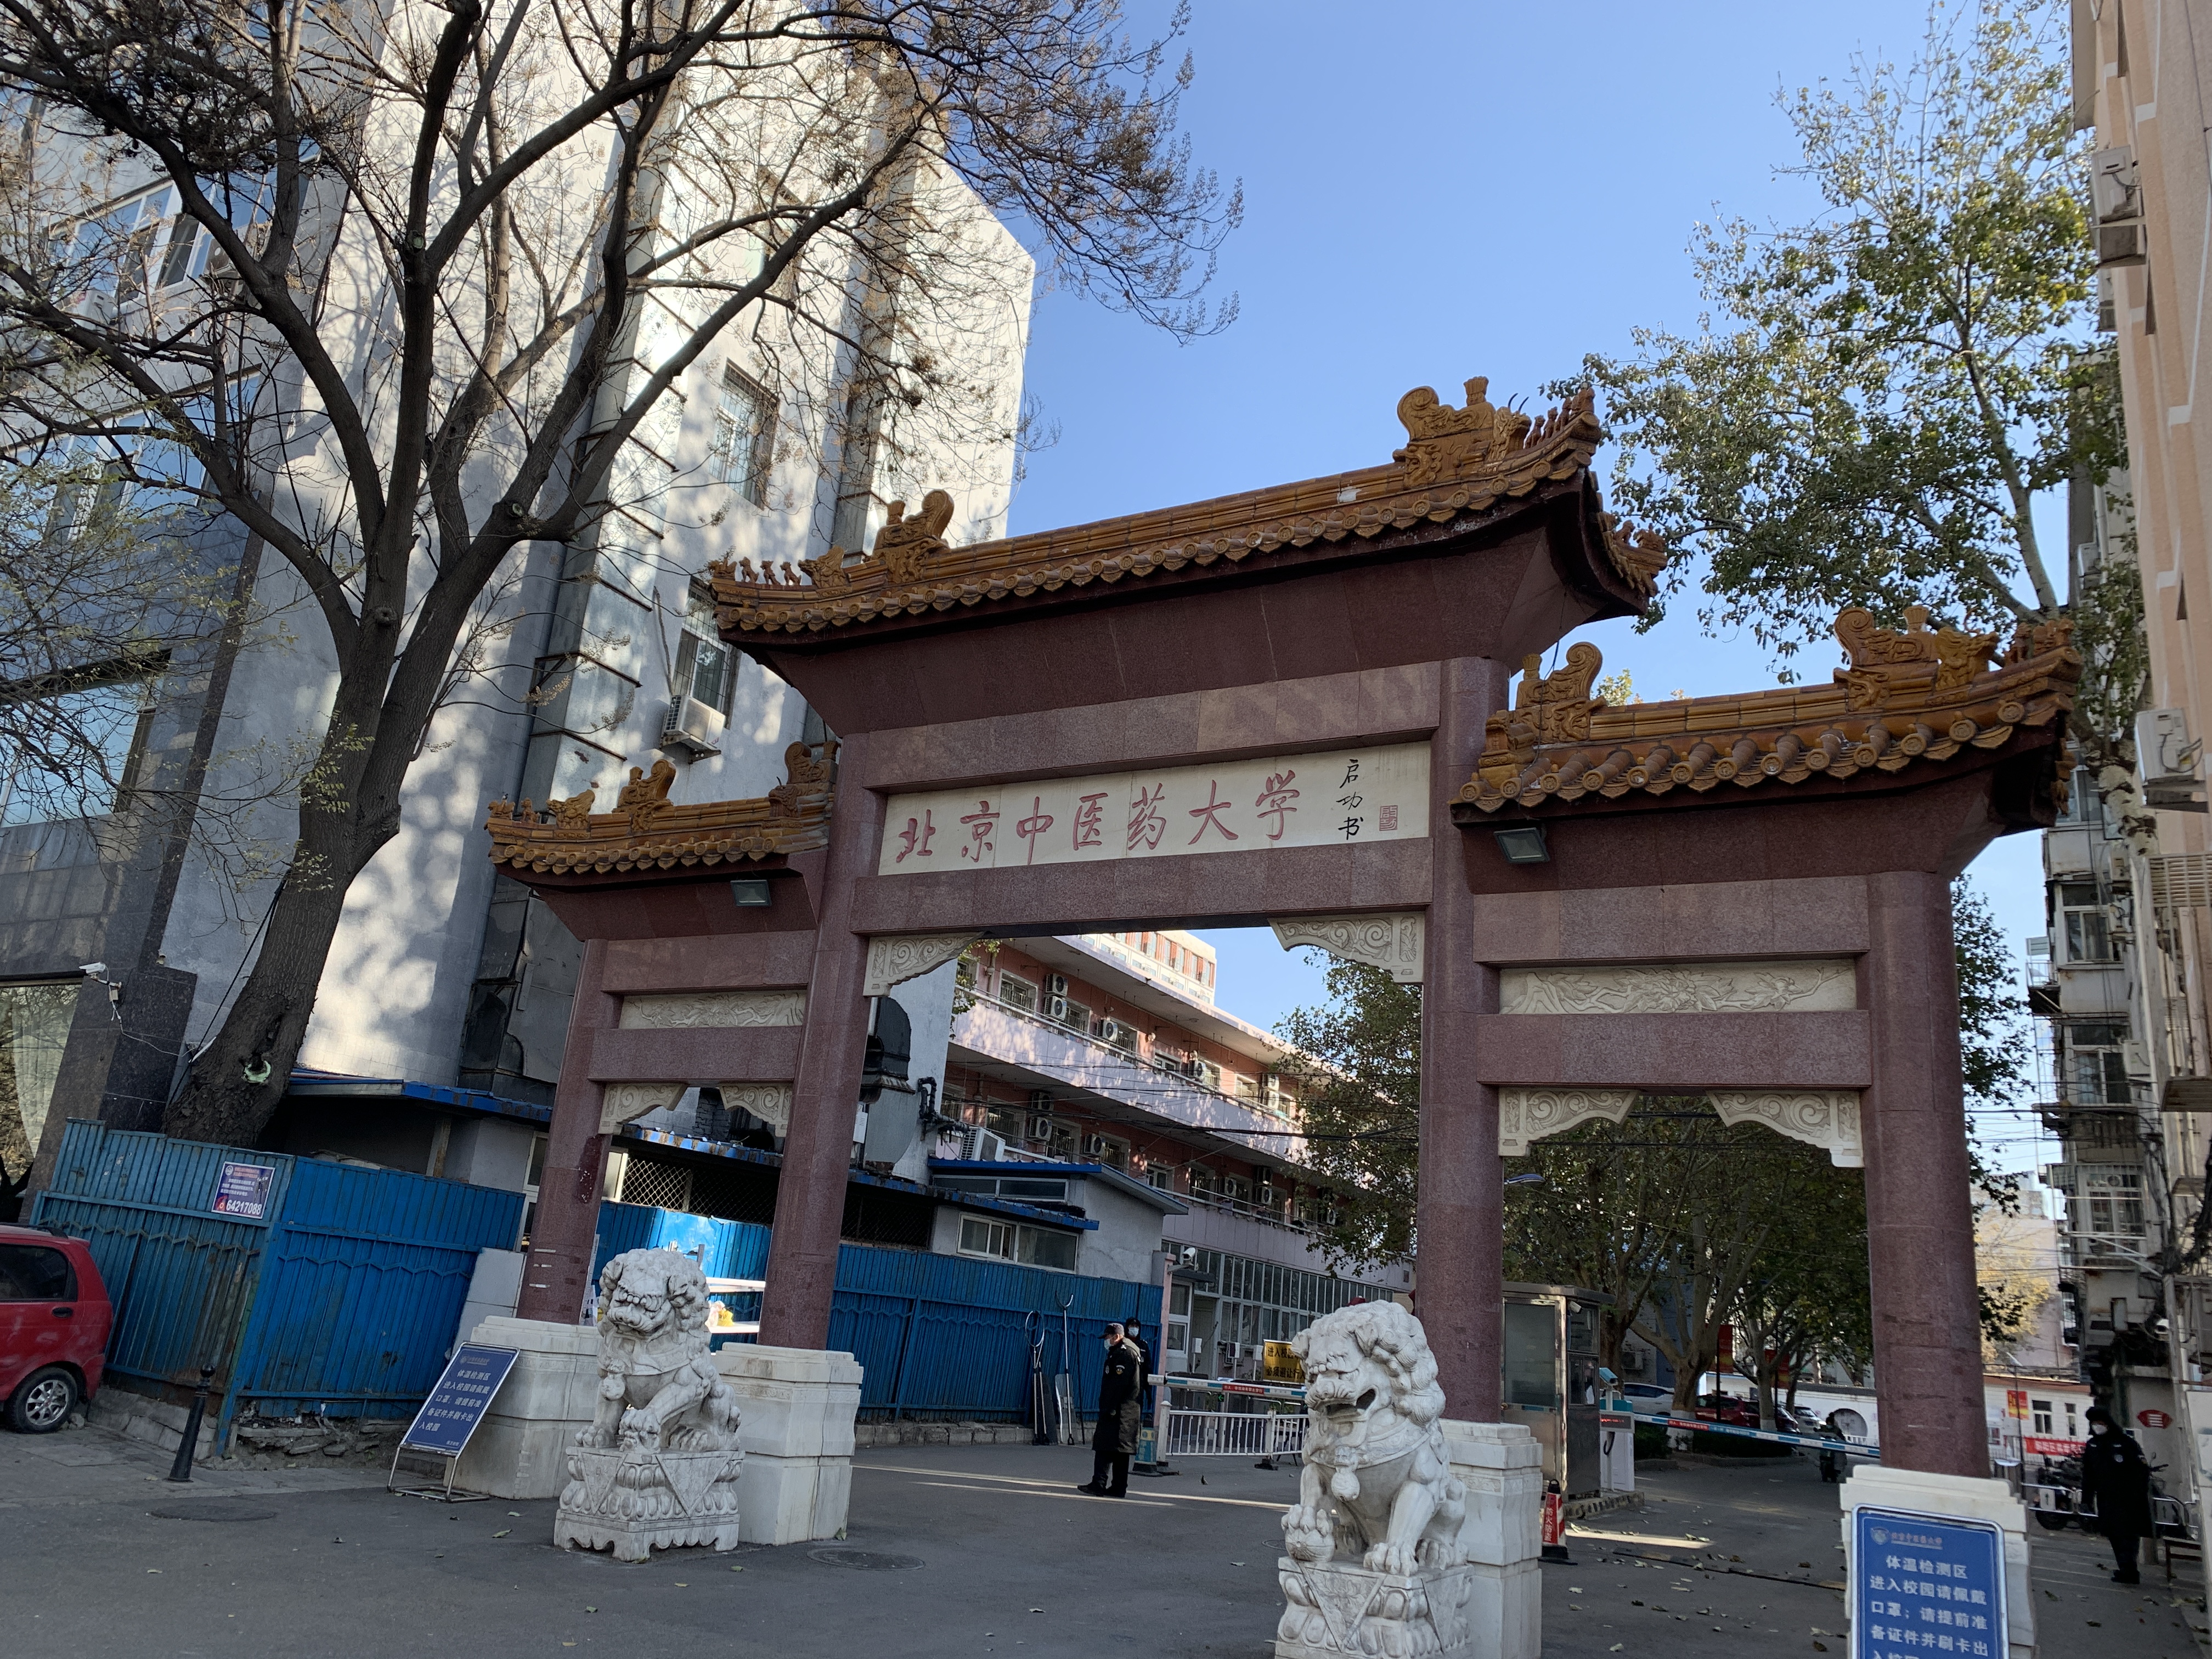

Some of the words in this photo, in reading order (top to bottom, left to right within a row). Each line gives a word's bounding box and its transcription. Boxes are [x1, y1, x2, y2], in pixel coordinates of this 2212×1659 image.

[1336, 759, 1364, 840] 启功书
[895, 770, 1302, 865] 北京中医药大学
[225, 1200, 262, 1215] 64217088
[456, 1369, 491, 1381] 体温检测区
[443, 1381, 490, 1394] 进入校园请佩戴
[418, 1421, 441, 1432] 入校园
[427, 1408, 473, 1422] 备证件并刷卡出
[1544, 1507, 1554, 1542] 防火防盗
[1886, 1555, 1968, 1579] 体温检测区
[1870, 1575, 1988, 1605] 进入校园请佩戴
[1871, 1624, 1989, 1657] 备证件并刷卡出
